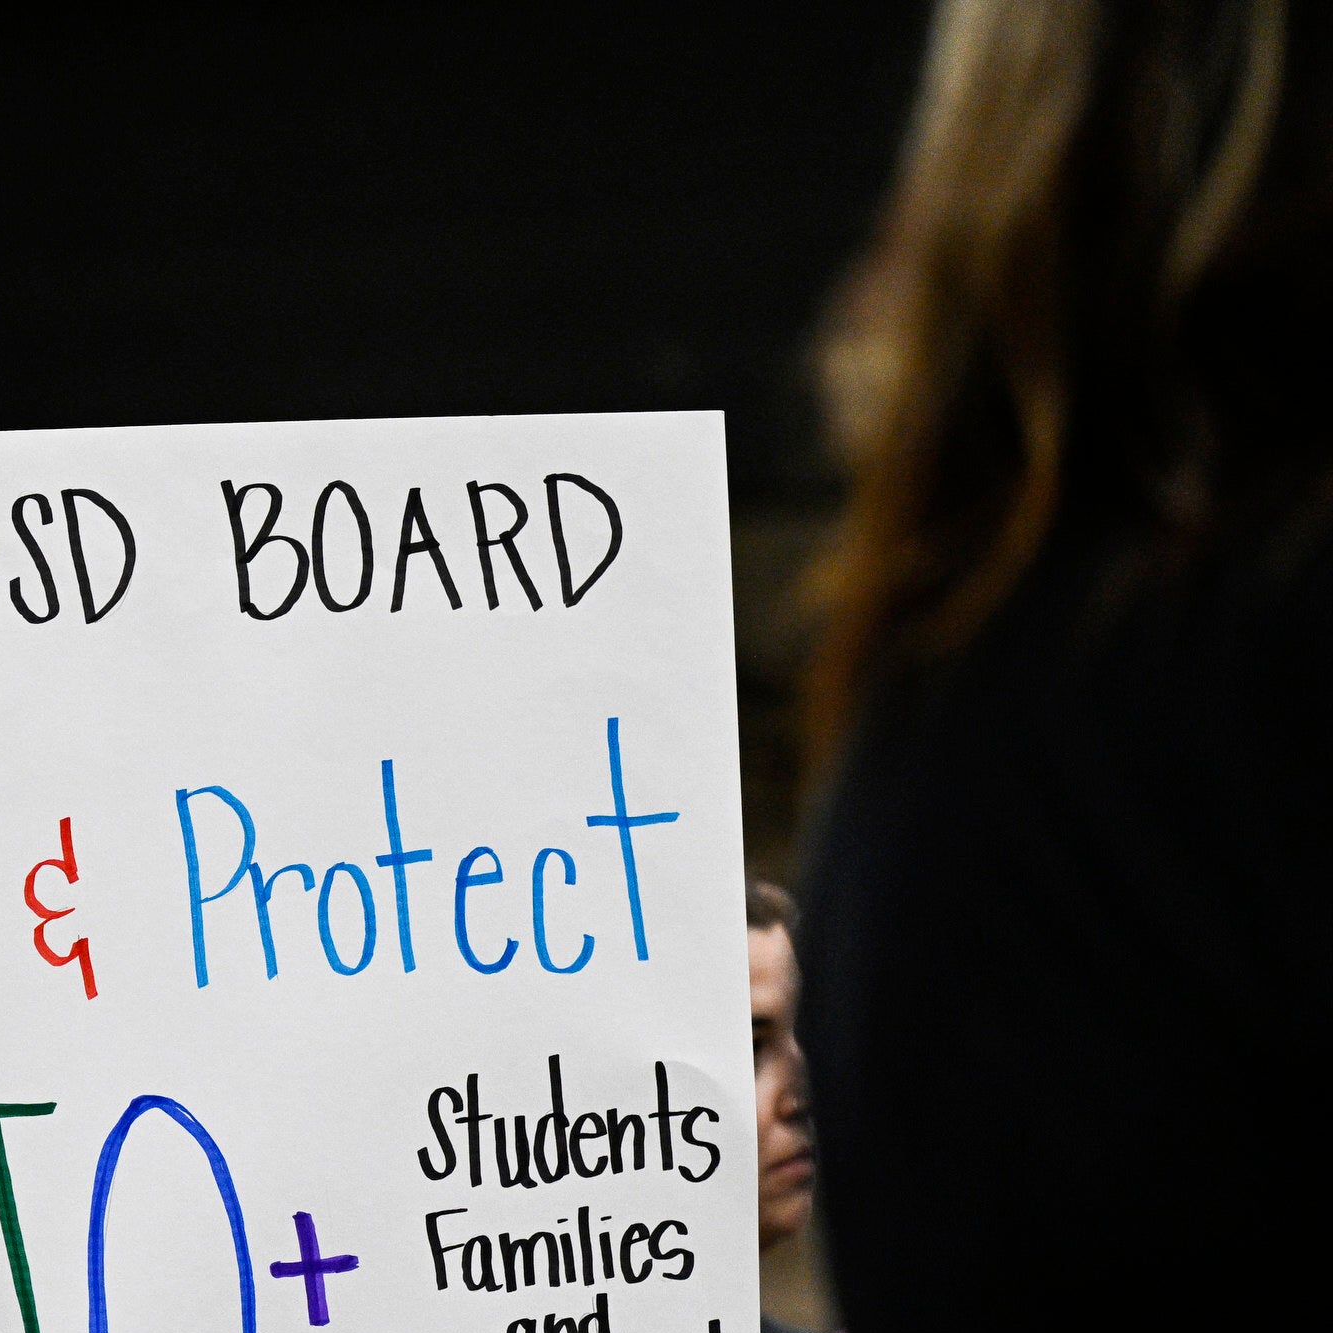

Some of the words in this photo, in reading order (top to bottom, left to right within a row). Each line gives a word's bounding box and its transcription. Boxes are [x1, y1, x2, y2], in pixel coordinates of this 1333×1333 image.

[221, 473, 622, 621] BOARD
[24, 816, 99, 1000] &
[176, 717, 680, 989] Protect
[417, 1054, 721, 1188] Students
[425, 1206, 694, 1292] Families
